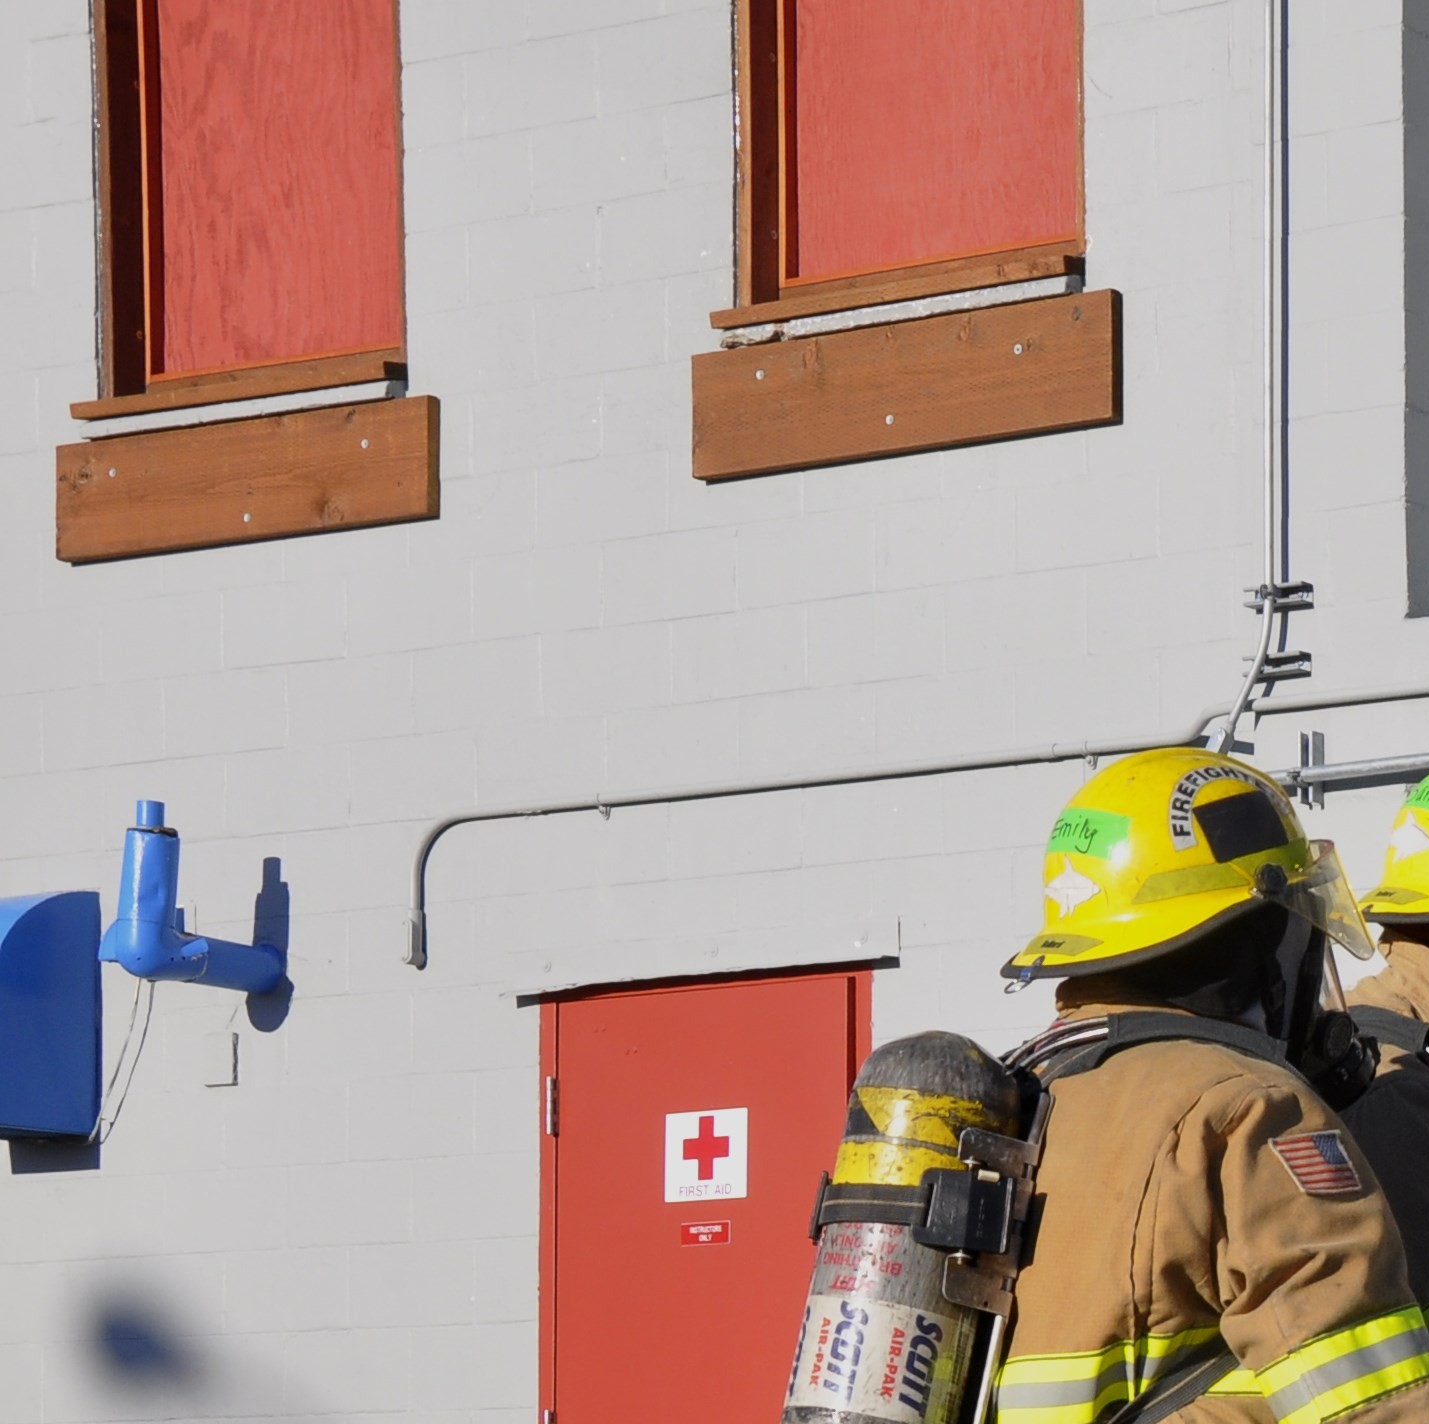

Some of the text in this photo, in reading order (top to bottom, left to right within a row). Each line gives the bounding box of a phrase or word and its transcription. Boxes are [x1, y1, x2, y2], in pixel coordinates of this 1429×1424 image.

[1051, 814, 1098, 854] Emily
[1171, 765, 1288, 837] FIREFIGHT
[679, 1183, 732, 1197] FIRST AID
[880, 1326, 906, 1399] AIR-PAK
[899, 1314, 944, 1419] SCOTT
